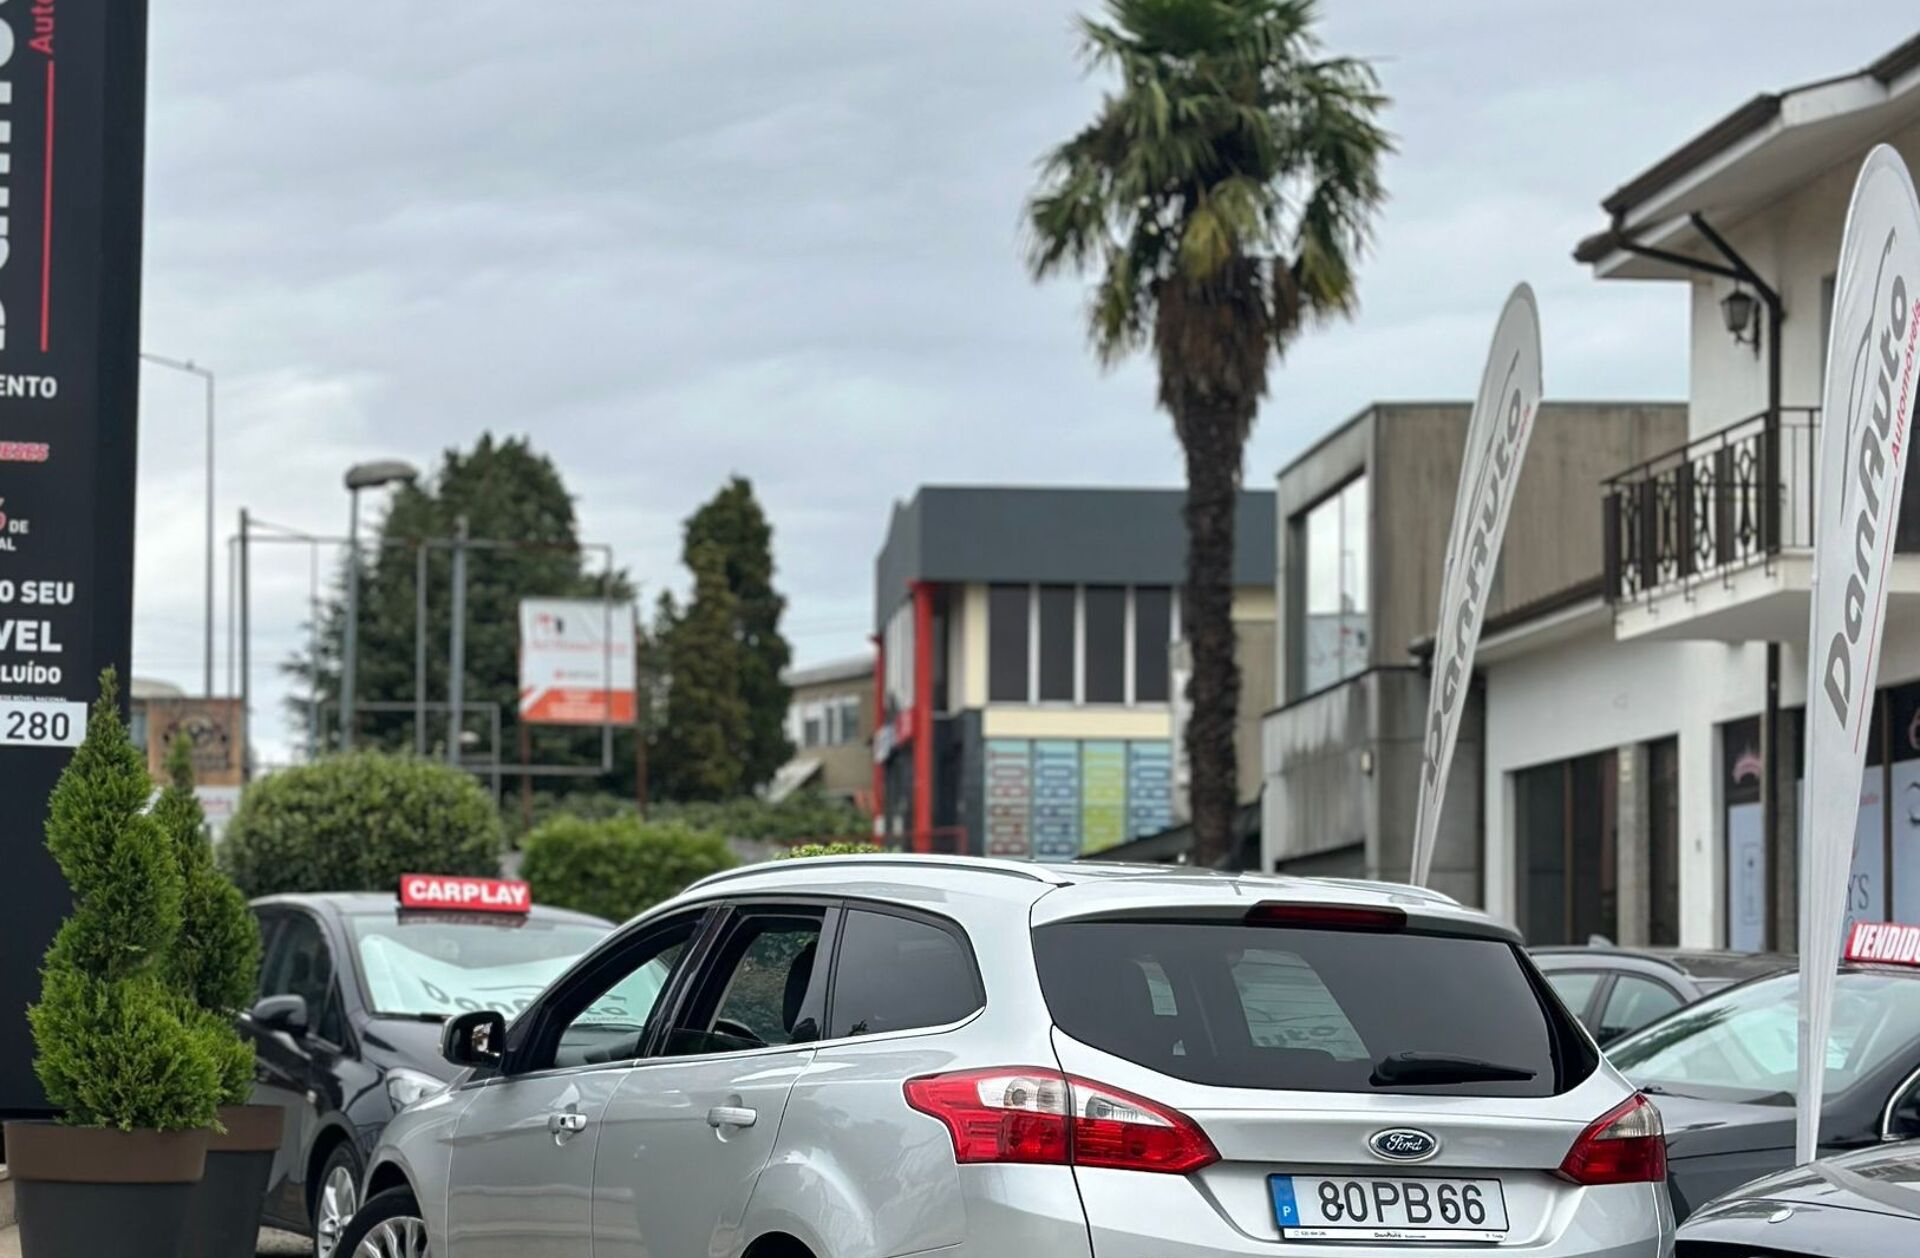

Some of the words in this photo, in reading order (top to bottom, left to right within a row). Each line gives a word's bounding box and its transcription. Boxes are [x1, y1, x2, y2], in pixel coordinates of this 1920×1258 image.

[30, 0, 54, 54] Aut
[1824, 275, 1908, 731] DanAuto
[9, 520, 29, 533] DE
[20, 581, 74, 604] SEU
[1, 661, 61, 684] LUÍDO
[6, 711, 69, 740] 280
[408, 880, 526, 904] CARPLAY
[1851, 923, 1920, 963] VENDID
[1386, 1133, 1423, 1150] Ford
[1283, 1206, 1291, 1217] P
[1318, 1180, 1486, 1225] 80PB66
